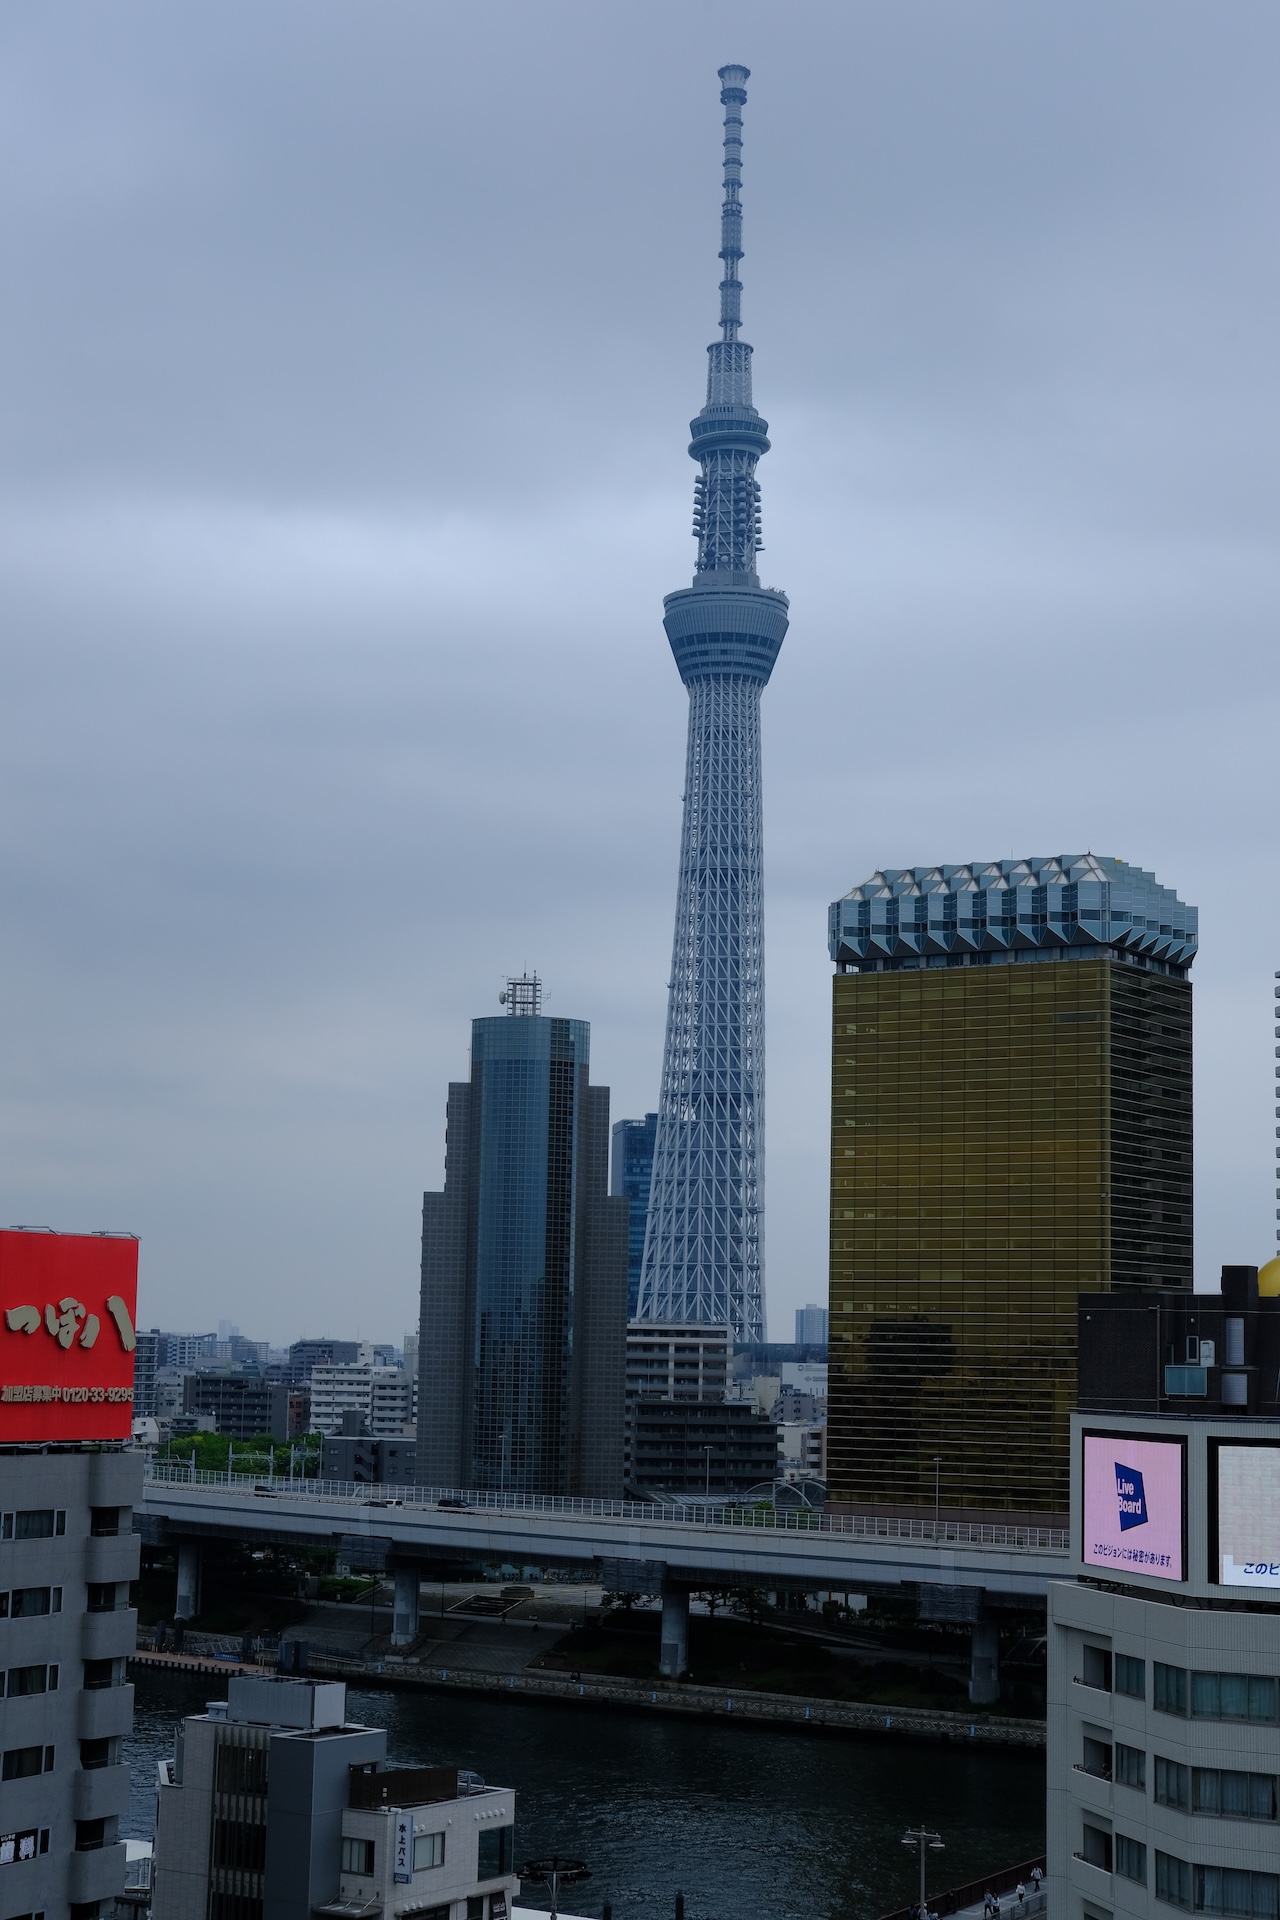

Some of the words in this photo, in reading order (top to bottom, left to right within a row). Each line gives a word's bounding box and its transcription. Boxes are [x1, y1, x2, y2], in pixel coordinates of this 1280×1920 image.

[1, 1385, 61, 1402] 加盟店募集中
[62, 1387, 134, 1402] 0120-33-9295
[1117, 1478, 1134, 1495] Live
[1118, 1496, 1142, 1515] Board
[398, 1823, 407, 1867] 水上バス
